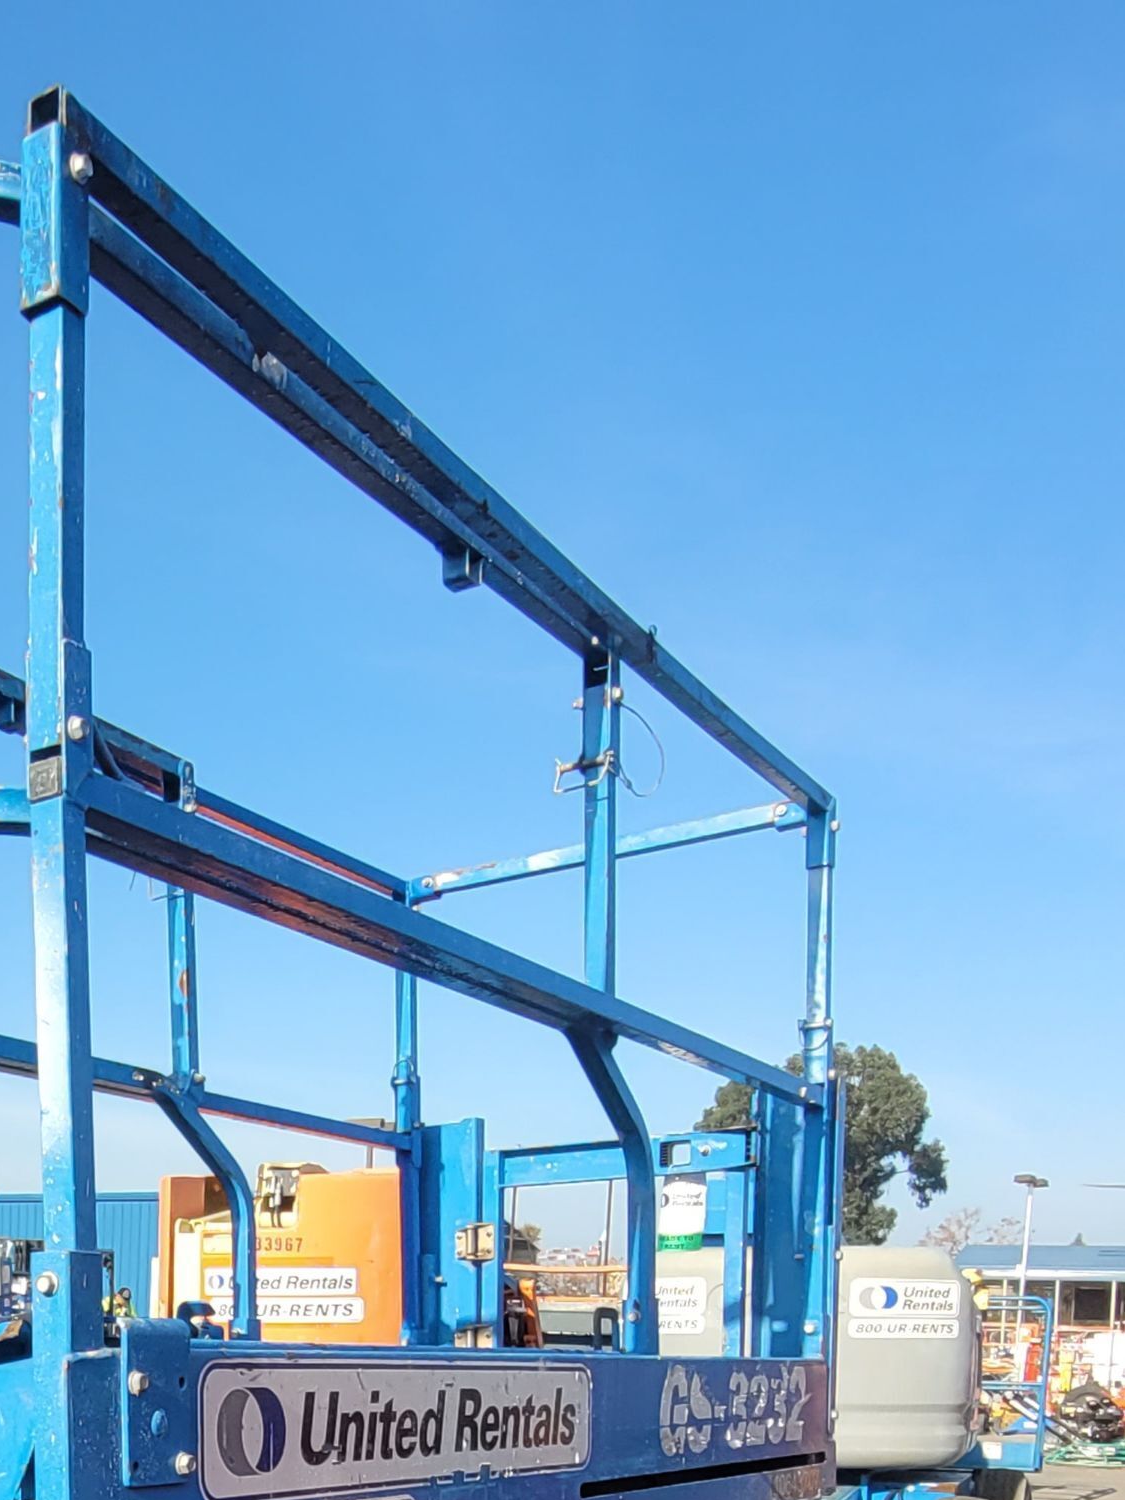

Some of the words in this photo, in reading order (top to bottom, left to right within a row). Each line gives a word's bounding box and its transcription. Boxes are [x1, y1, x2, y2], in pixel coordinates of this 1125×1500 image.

[286, 1275, 353, 1290] Rentals
[903, 1286, 951, 1299] United
[659, 1297, 698, 1308] entals
[902, 1299, 954, 1311] Rentals
[300, 1388, 447, 1466] United
[454, 1386, 576, 1453] Rentals
